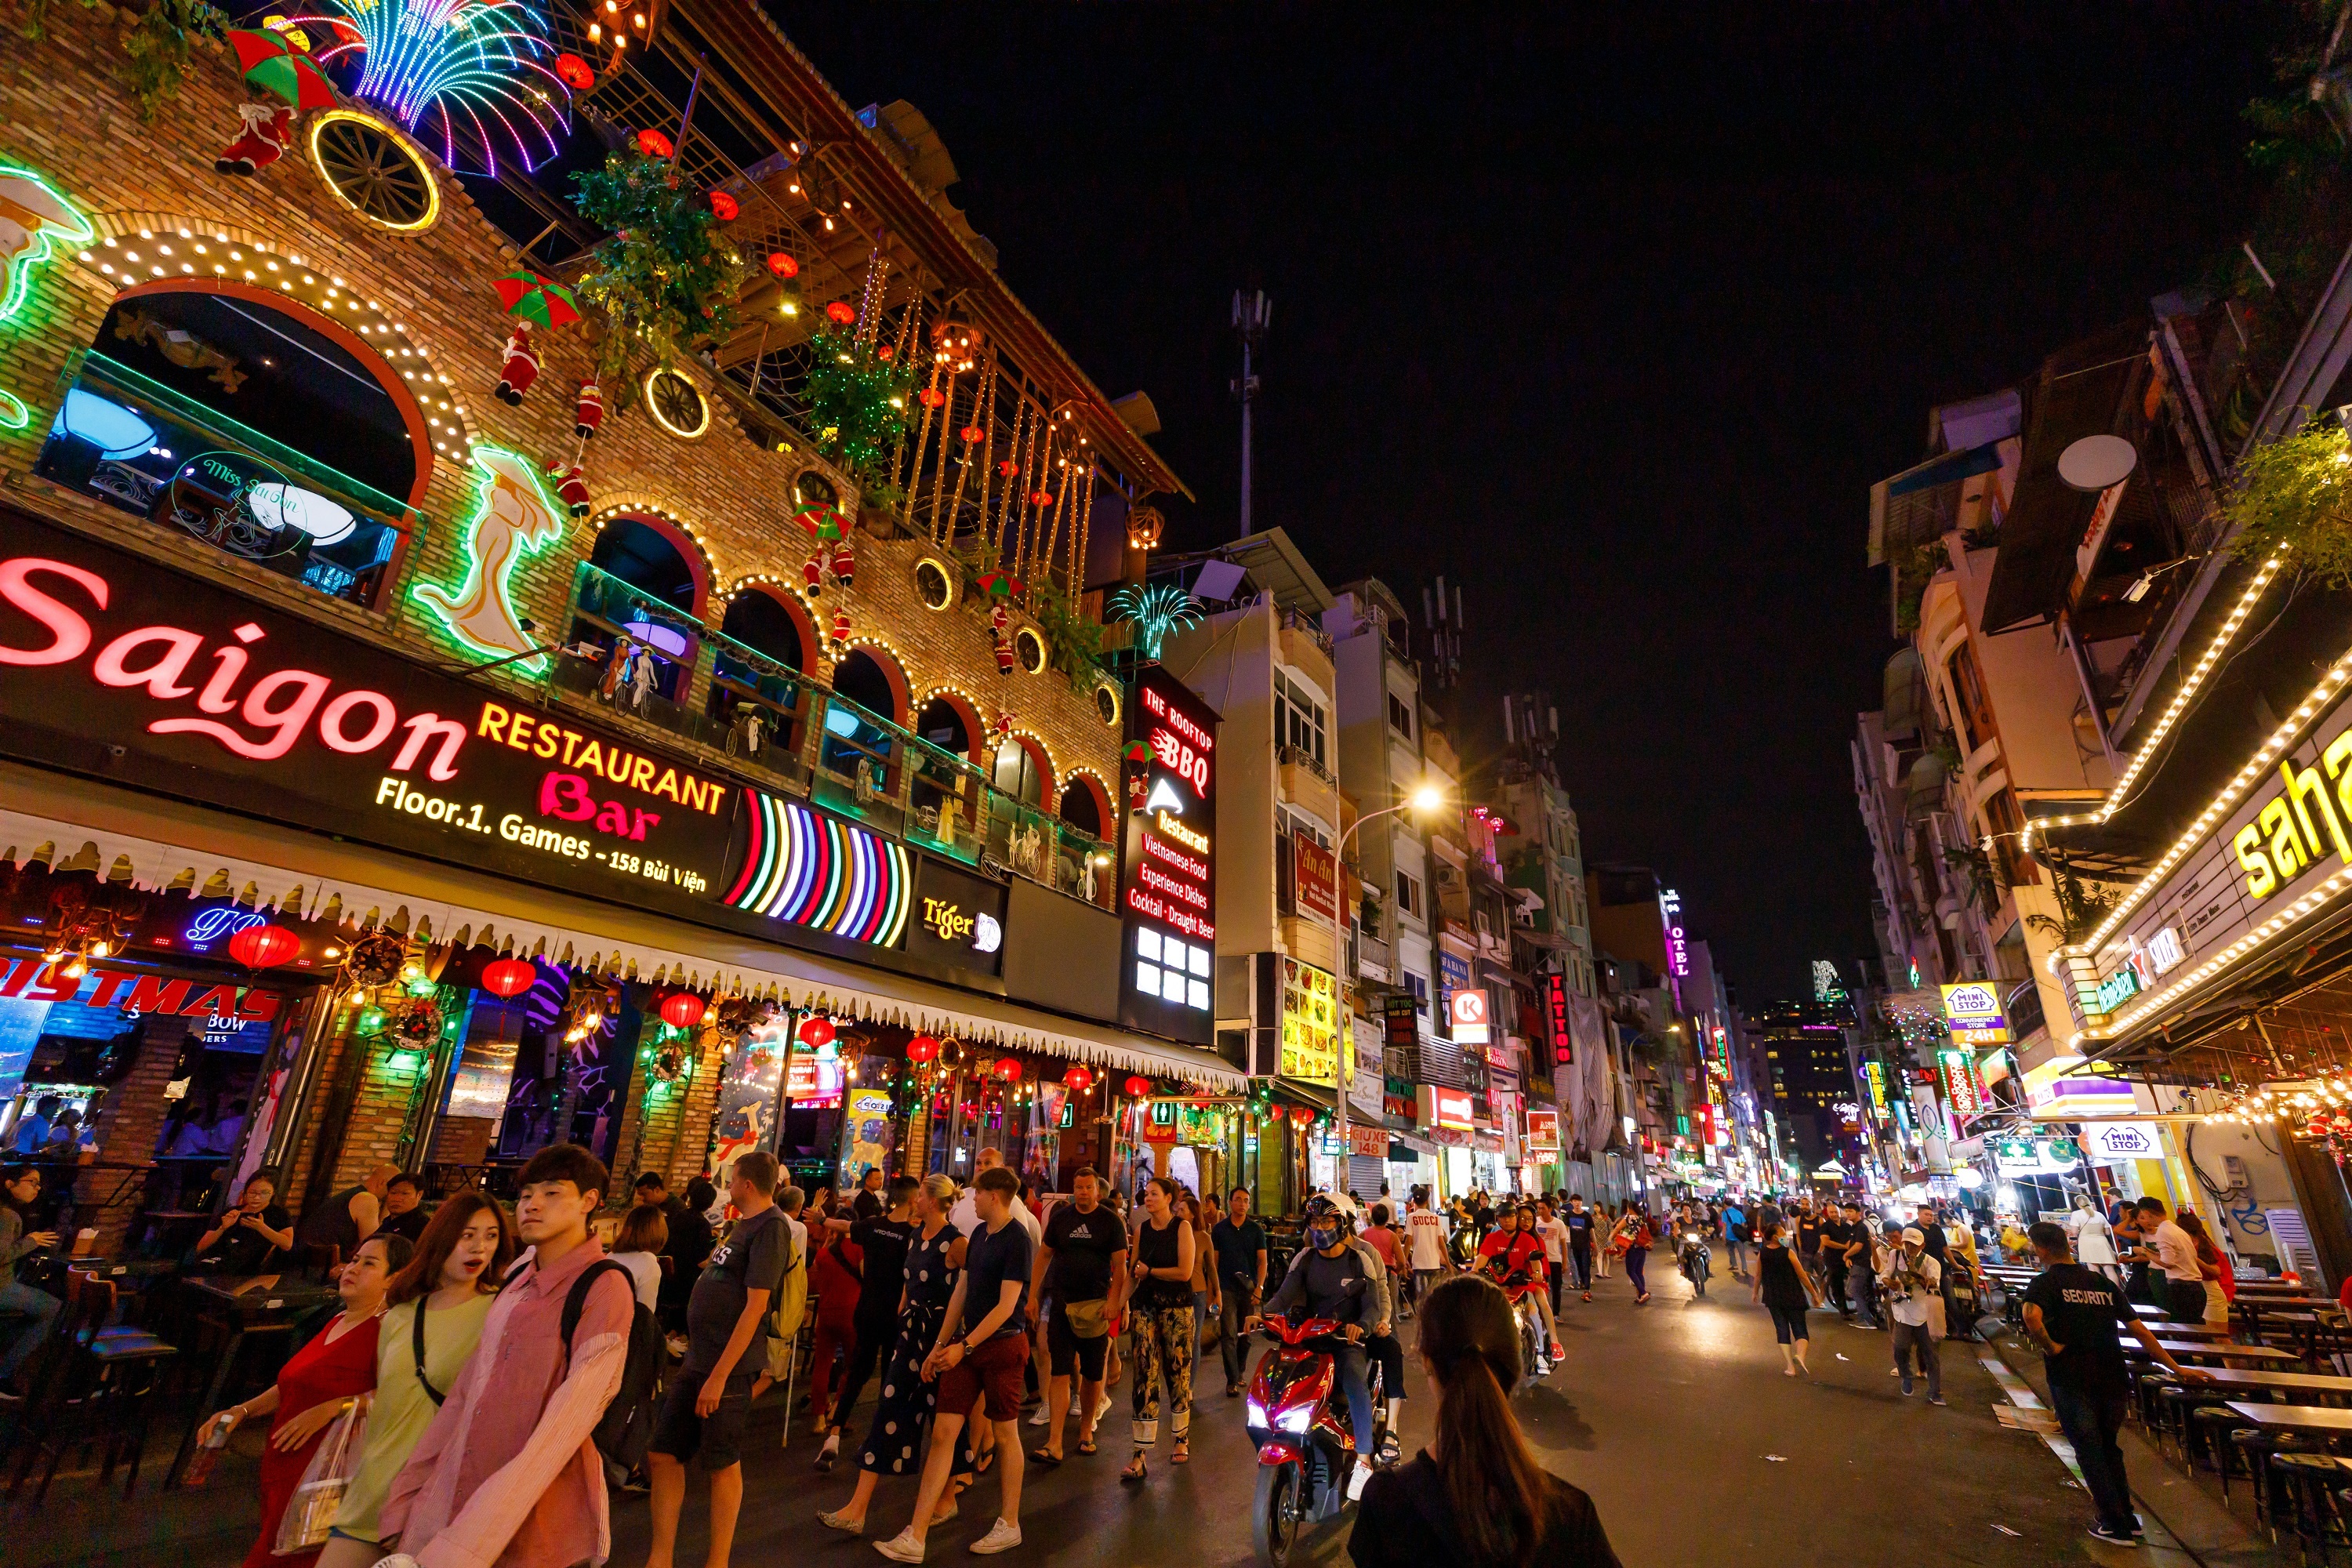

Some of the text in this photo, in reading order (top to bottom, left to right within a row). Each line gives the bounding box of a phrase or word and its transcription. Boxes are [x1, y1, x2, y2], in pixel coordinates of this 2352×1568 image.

[203, 459, 241, 487] Miss
[0, 557, 467, 782] Saigon
[1145, 688, 1212, 752] THE ROOFTOP
[477, 702, 726, 815] RESTAURANT
[1152, 728, 1208, 799] BBQ
[540, 771, 661, 842] Bar
[499, 814, 590, 860] Games
[608, 851, 639, 875] 158
[642, 859, 670, 884] Bùi
[673, 868, 706, 894] Viện
[1159, 810, 1209, 855] Restaurant
[1145, 833, 1207, 880] Vietnamese Food
[1303, 849, 1332, 884] An An
[1142, 863, 1207, 909] Experience Dishes
[924, 897, 975, 940] Tiger
[1131, 889, 1162, 918] Cocktail
[1168, 906, 1197, 934] Draught
[1199, 919, 1214, 940] Beer
[0, 958, 284, 1022] ISTMAS
[1958, 1000, 1986, 1009] STOP
[2096, 971, 2135, 1014] Heineken
[1550, 975, 1570, 1062] TATTOO
[1963, 1029, 1995, 1042] 24H
[1358, 1142, 1379, 1154] 148
[1412, 1216, 1439, 1226] GUCCI
[2062, 1288, 2114, 1306] SECURITY
